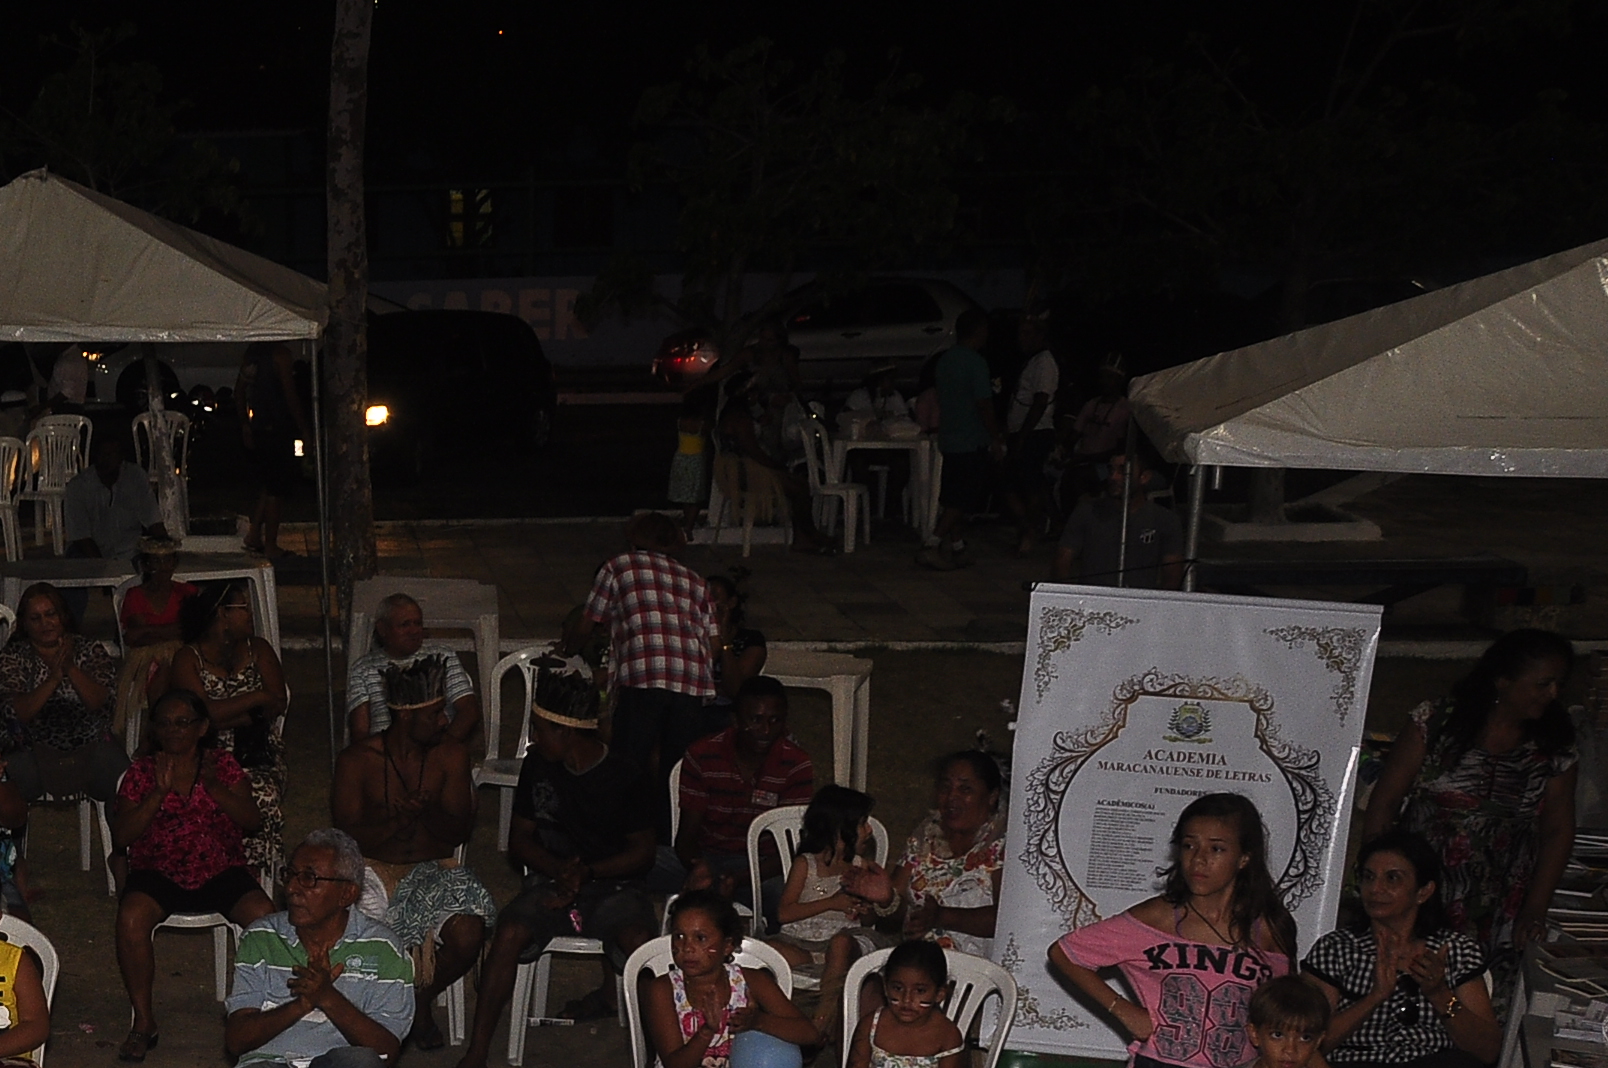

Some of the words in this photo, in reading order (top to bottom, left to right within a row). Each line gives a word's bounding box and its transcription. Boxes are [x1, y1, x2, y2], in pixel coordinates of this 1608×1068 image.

[1143, 749, 1228, 766] ACADEMIA
[1097, 760, 1204, 779] MARACANAUENSE
[1206, 768, 1222, 779] DE
[1225, 770, 1272, 783] LETRAS
[1153, 972, 1254, 1068] 98
